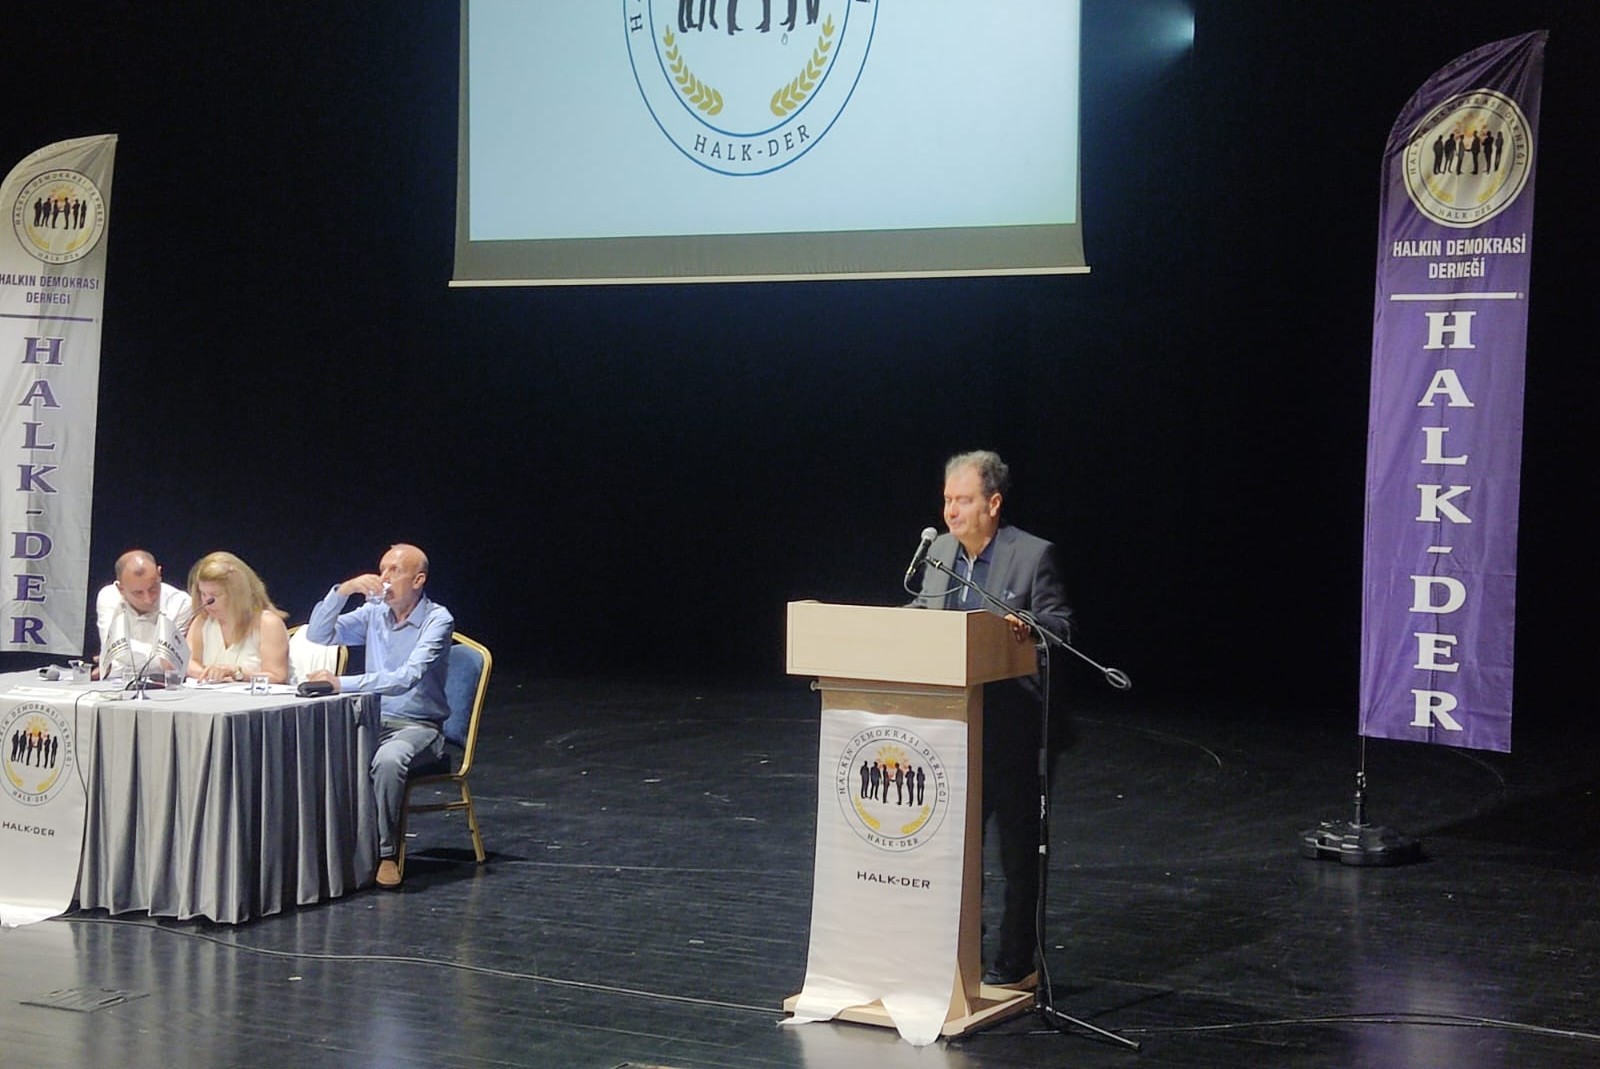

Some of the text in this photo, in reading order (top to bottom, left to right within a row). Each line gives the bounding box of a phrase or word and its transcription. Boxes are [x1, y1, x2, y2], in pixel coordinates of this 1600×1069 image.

[693, 124, 810, 161] HALK-DER
[1392, 233, 1526, 257] HALKIN DEMOKRASİ
[1428, 257, 1485, 279] DERNEĞİ
[0, 273, 36, 287] HALKIN
[2, 820, 56, 837] HALK-DER
[866, 832, 920, 848] HALK-DER
[857, 870, 931, 889] HALK-DER
